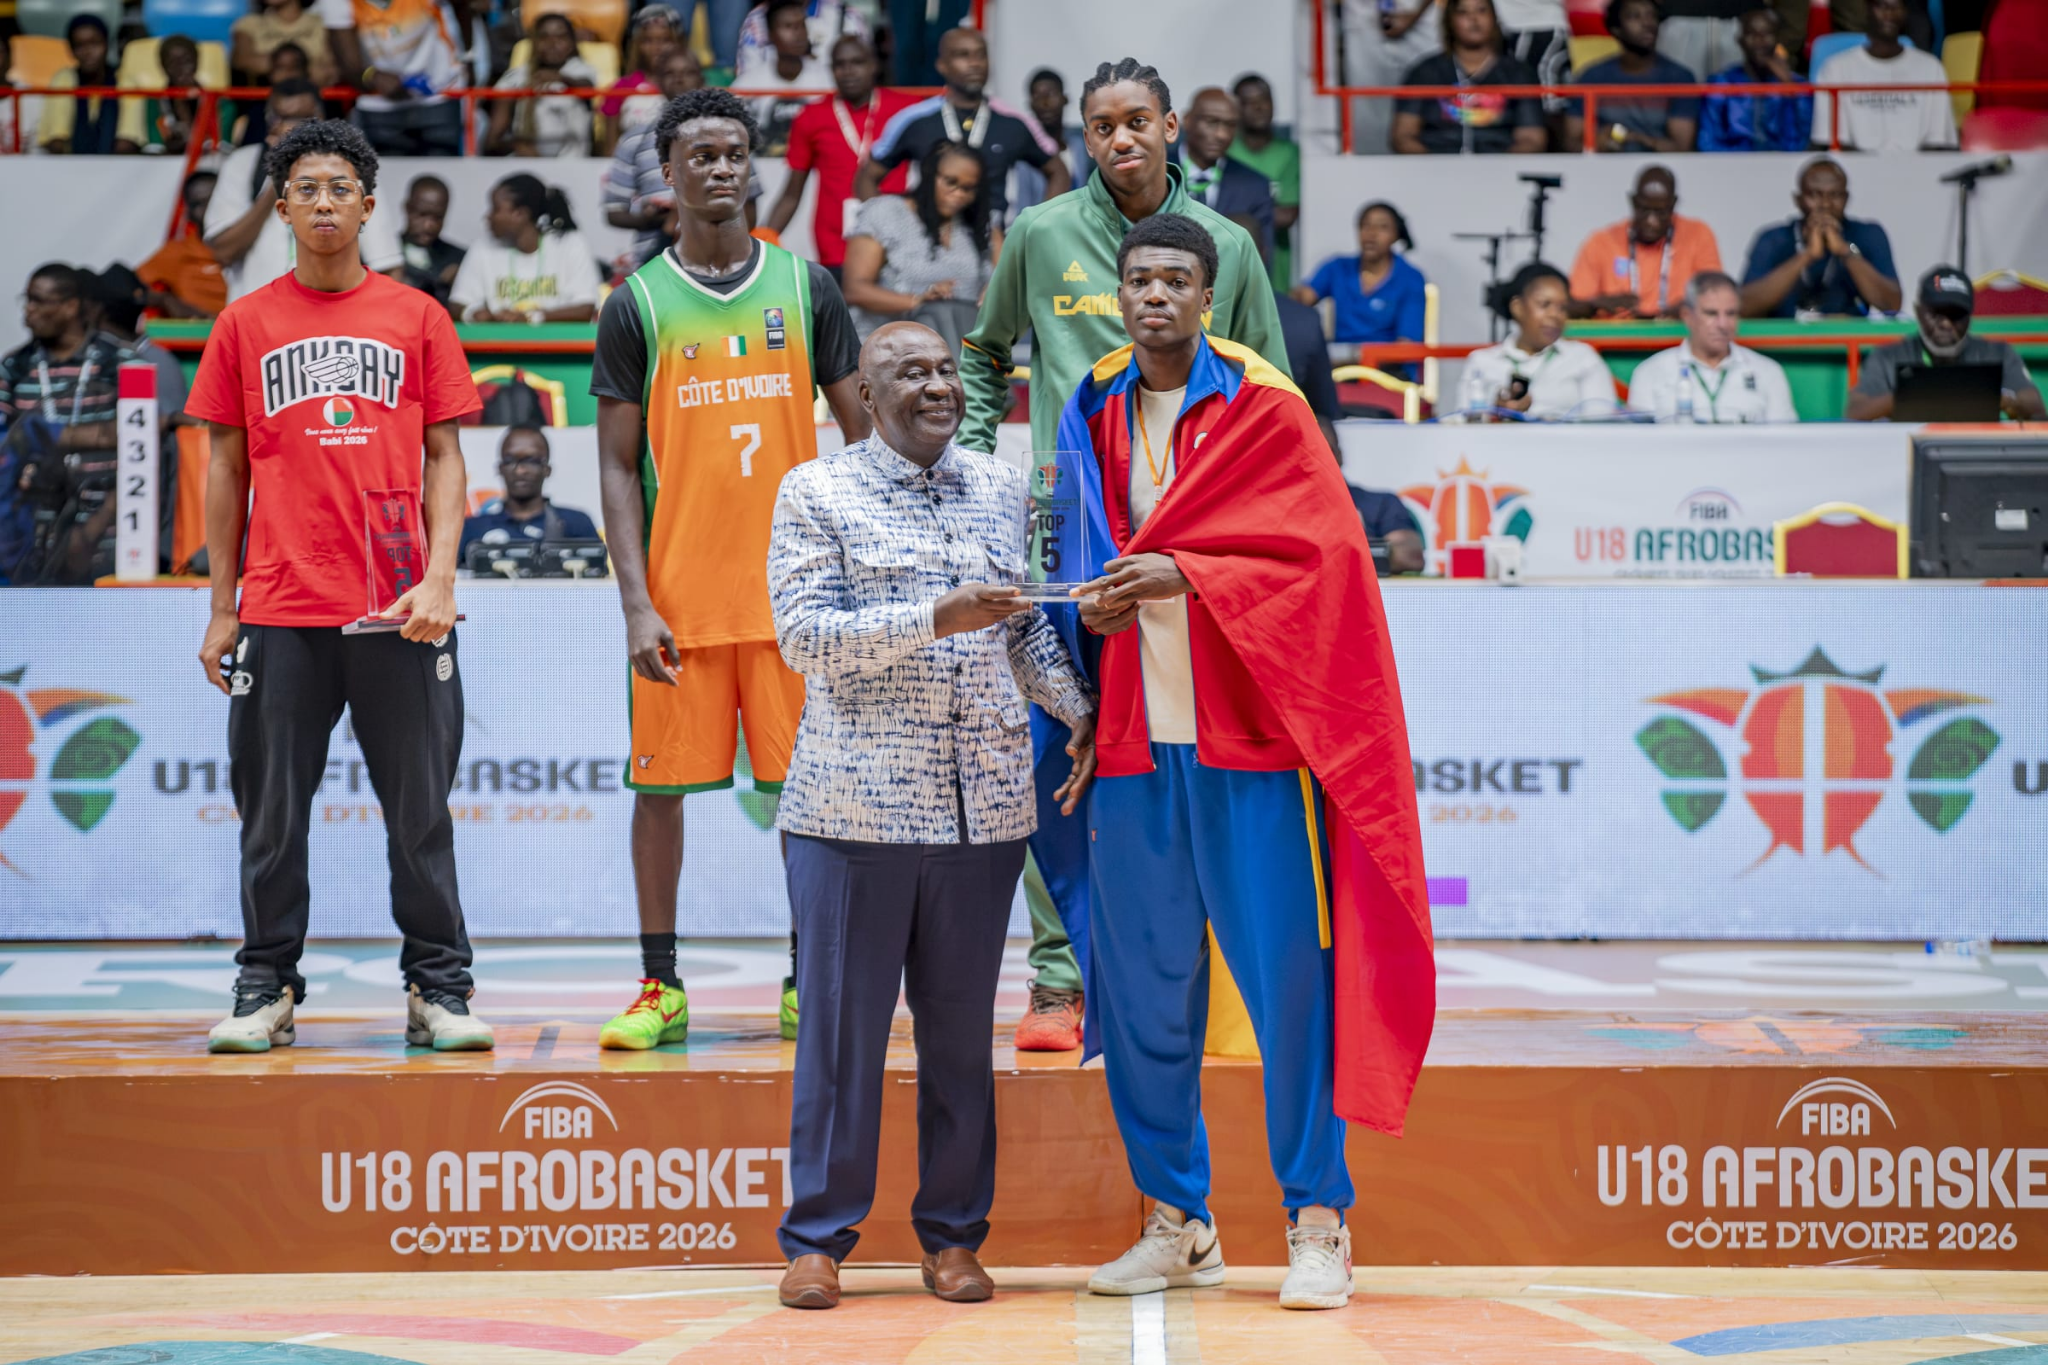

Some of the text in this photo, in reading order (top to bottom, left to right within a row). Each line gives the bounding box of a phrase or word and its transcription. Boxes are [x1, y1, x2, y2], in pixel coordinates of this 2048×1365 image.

[677, 373, 793, 408] CÔTE D'IVOIRE
[126, 406, 146, 428] 4
[127, 440, 146, 463] 3
[319, 435, 368, 446] Babi 2026
[730, 423, 762, 477] 7
[126, 475, 146, 497] 2
[124, 508, 139, 531] 1
[1036, 514, 1065, 531] TOP
[1041, 536, 1061, 573] 5
[1574, 526, 1626, 562] U18
[154, 758, 231, 794] U1
[525, 1106, 593, 1139] FIBA
[1802, 1102, 1871, 1136] FIBA
[321, 1147, 794, 1213] U18 AFROBASKET
[1597, 1144, 2048, 1210] U18 AFROBASKE
[390, 1221, 737, 1255] CÔTE D'IVOIRE 2026
[1666, 1216, 2018, 1251] CÔTE D'IVOIRE 2026
